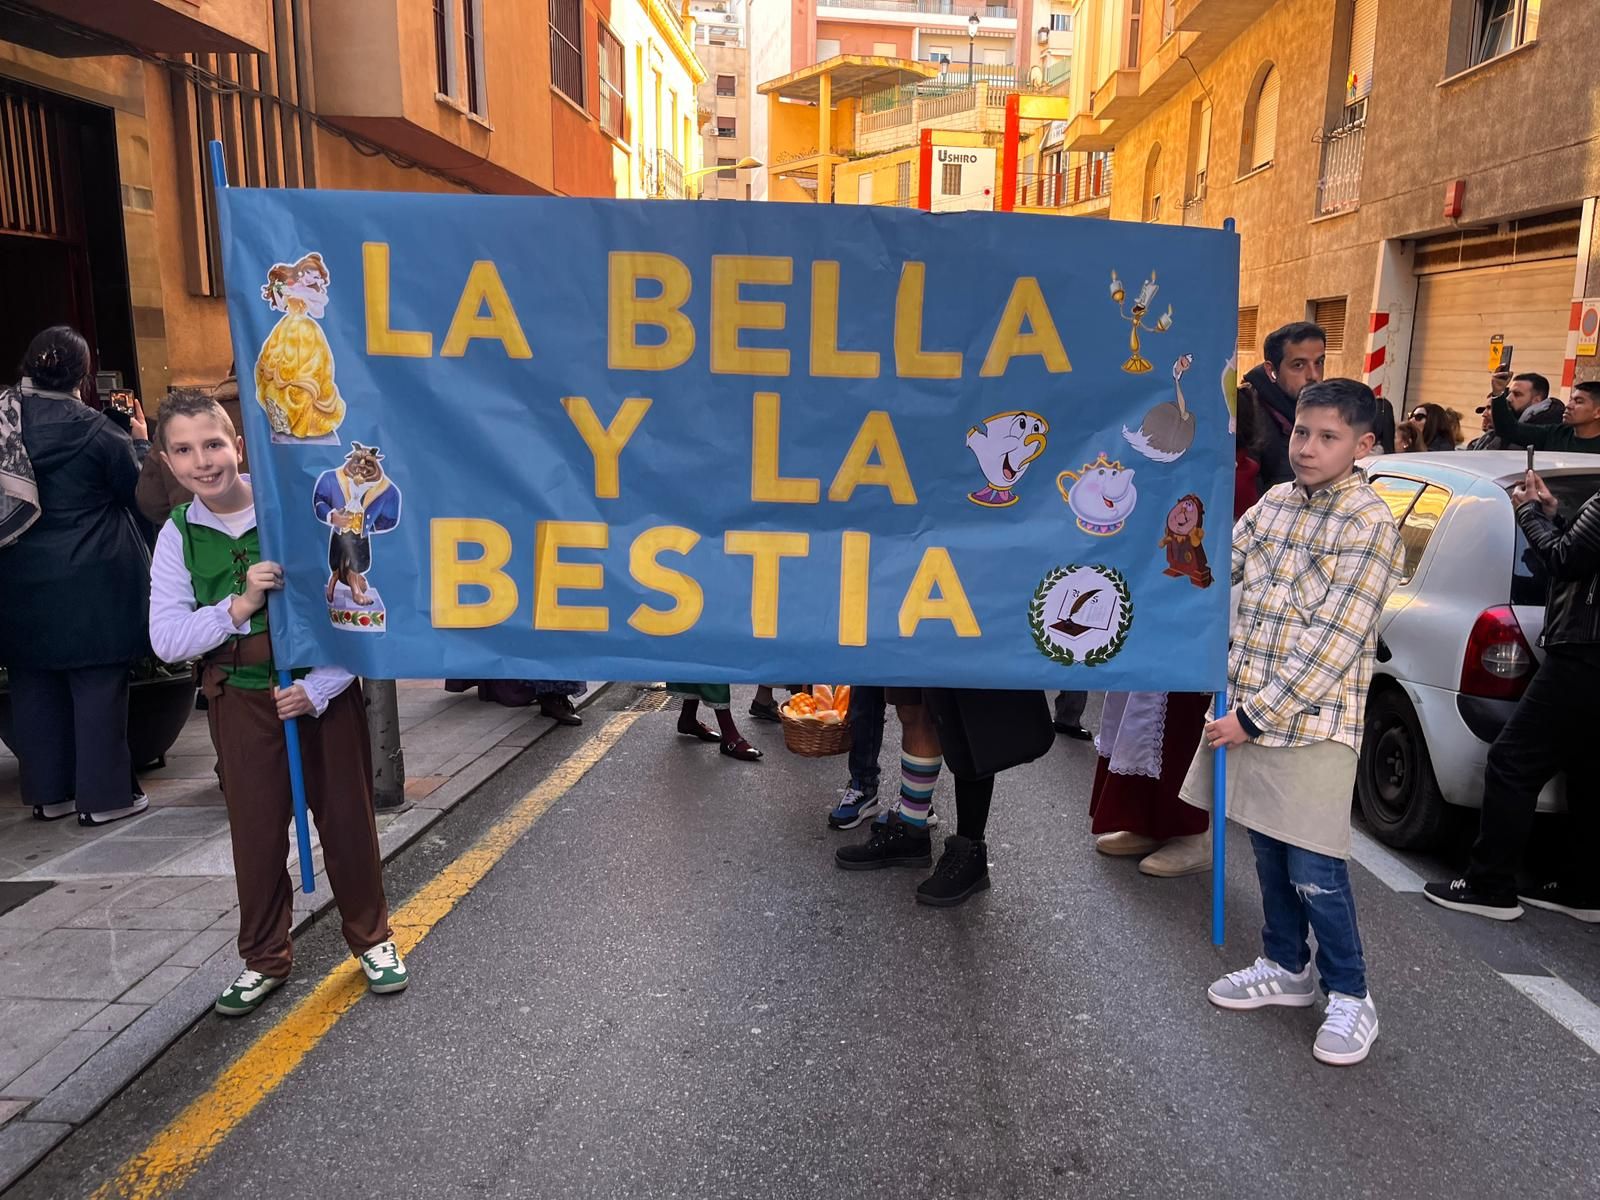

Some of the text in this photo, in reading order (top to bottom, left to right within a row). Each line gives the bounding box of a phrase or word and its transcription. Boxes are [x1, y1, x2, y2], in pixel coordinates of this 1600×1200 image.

[362, 241, 1073, 379] LA BELLA
[560, 391, 918, 506] Y LA
[430, 517, 982, 647] BESTIA
